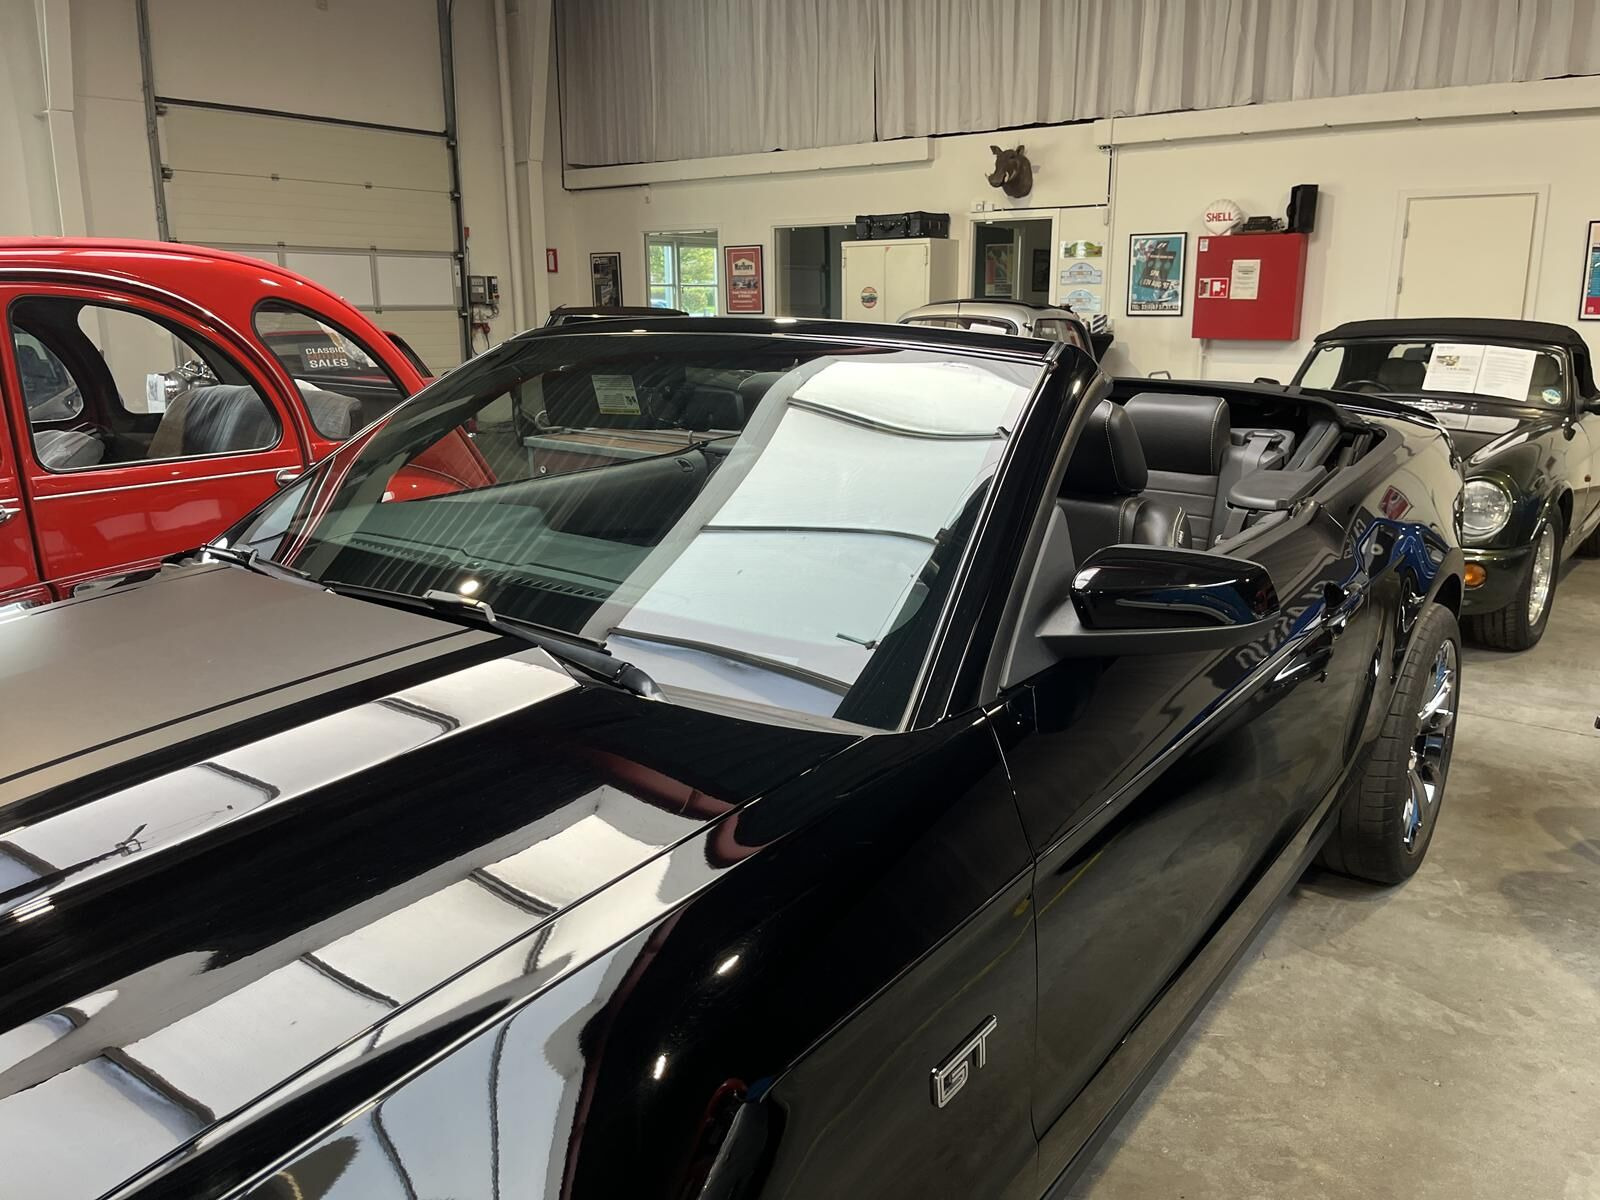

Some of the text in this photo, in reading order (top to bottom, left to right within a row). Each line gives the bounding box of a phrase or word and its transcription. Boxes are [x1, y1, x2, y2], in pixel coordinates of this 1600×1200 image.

[1206, 212, 1234, 222] SHELL
[305, 347, 345, 355] CLASSIC
[309, 359, 349, 368] SALES
[930, 1014, 997, 1108] GT
